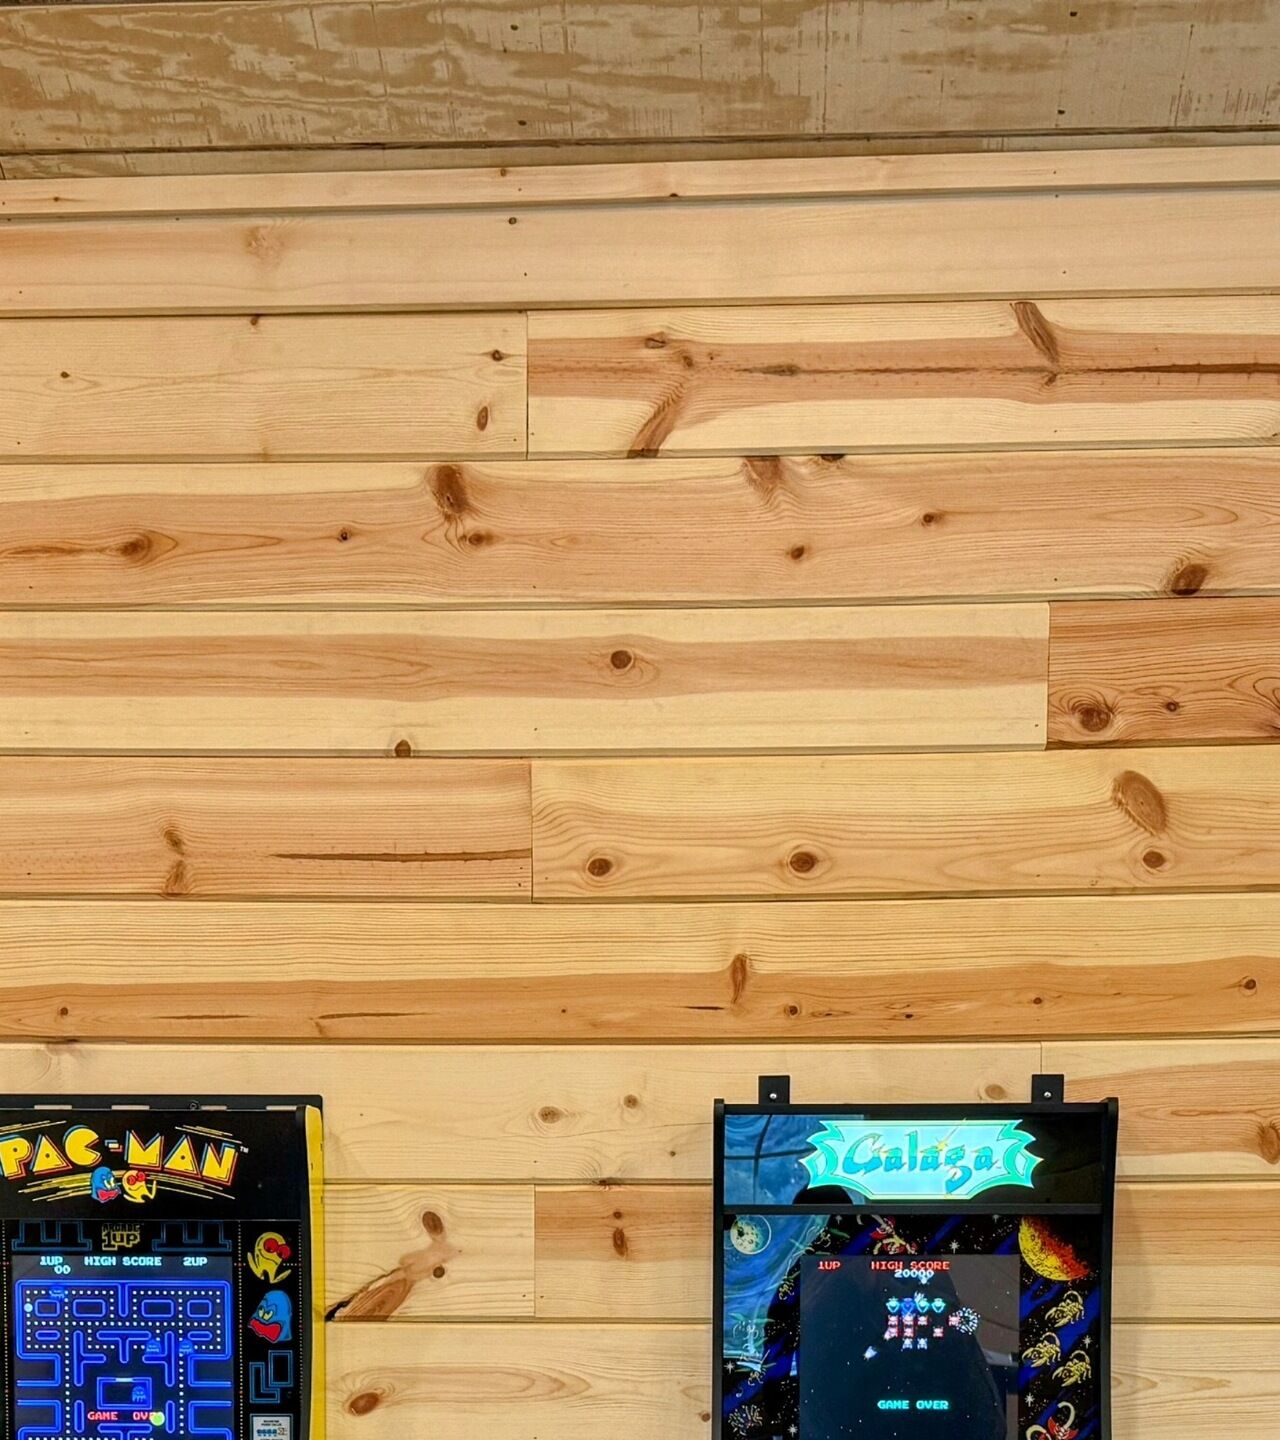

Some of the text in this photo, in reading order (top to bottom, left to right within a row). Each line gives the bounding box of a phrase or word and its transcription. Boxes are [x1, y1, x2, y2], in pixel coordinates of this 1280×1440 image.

[842, 1130, 997, 1194] Galaga
[39, 1256, 208, 1266] 1UP HIGH SCORE 2UP
[817, 1261, 951, 1270] 1UP HIGH SCORE
[894, 1269, 935, 1278] 20000
[877, 1400, 949, 1410] GAME OVER
[87, 1411, 118, 1421] GAME
